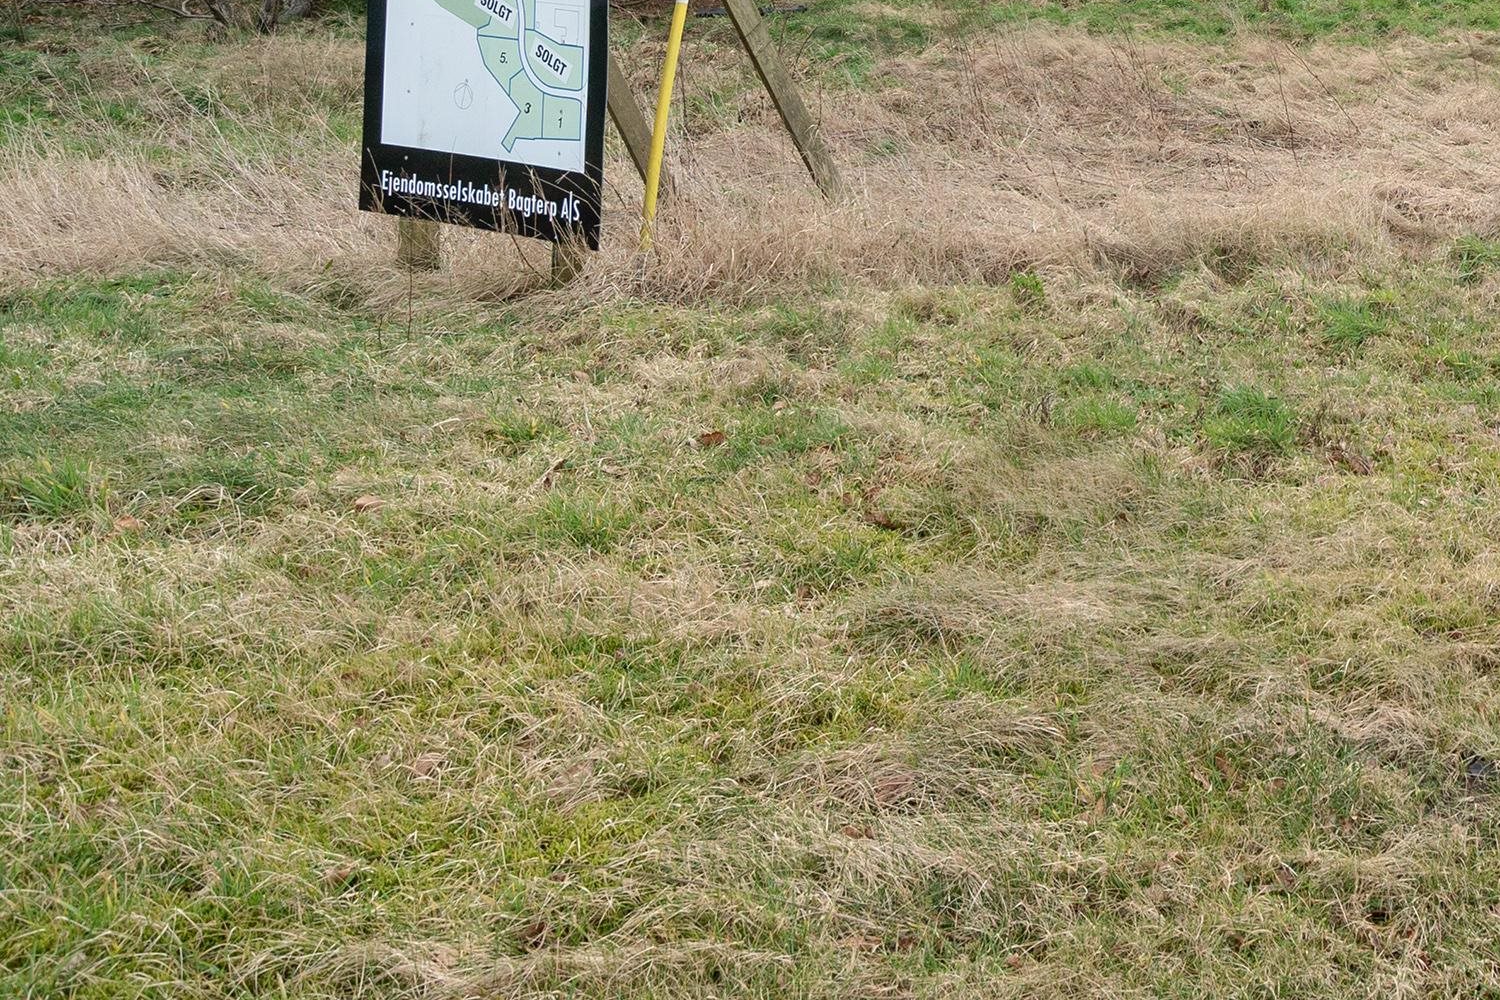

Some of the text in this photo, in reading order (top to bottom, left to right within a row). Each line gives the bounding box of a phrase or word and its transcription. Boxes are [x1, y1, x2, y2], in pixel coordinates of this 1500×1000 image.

[500, 52, 508, 64] 5.
[535, 44, 568, 76] SOLGT
[524, 102, 532, 114] 3
[558, 117, 562, 128] 1
[382, 170, 505, 208] Ejendomsselskabet
[508, 189, 558, 222] Bagterp
